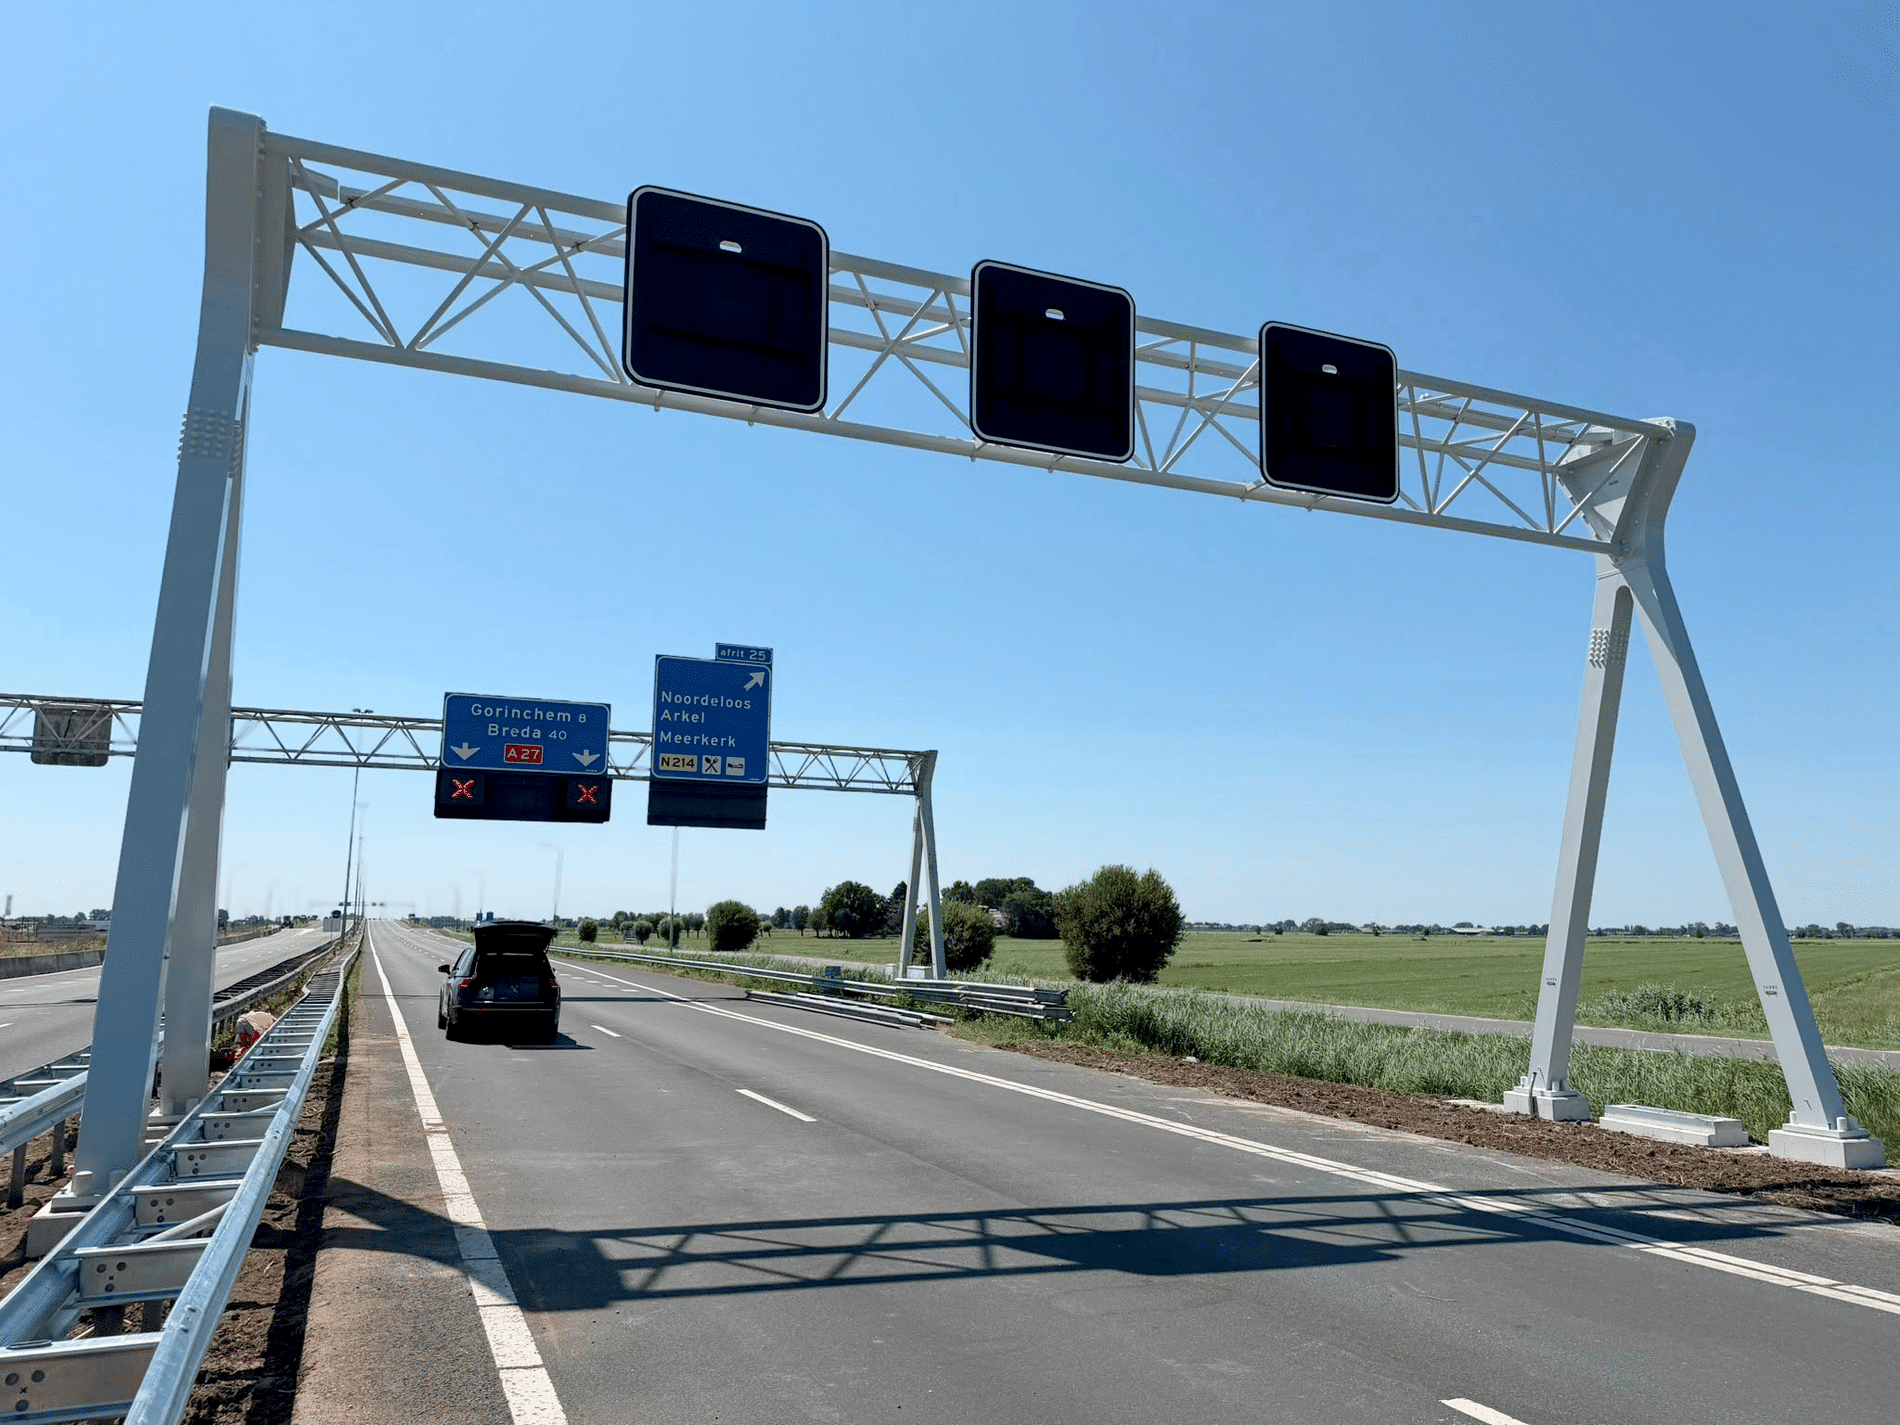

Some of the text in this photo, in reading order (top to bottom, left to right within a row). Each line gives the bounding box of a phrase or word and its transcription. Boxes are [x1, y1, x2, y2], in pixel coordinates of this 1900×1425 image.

[749, 650, 766, 660] 25
[662, 690, 751, 710] Noordeloos
[471, 704, 586, 723] Gorinchem 8
[660, 709, 704, 724] Arkel
[488, 724, 567, 740] Breda 40
[660, 730, 736, 748] Meerkerk
